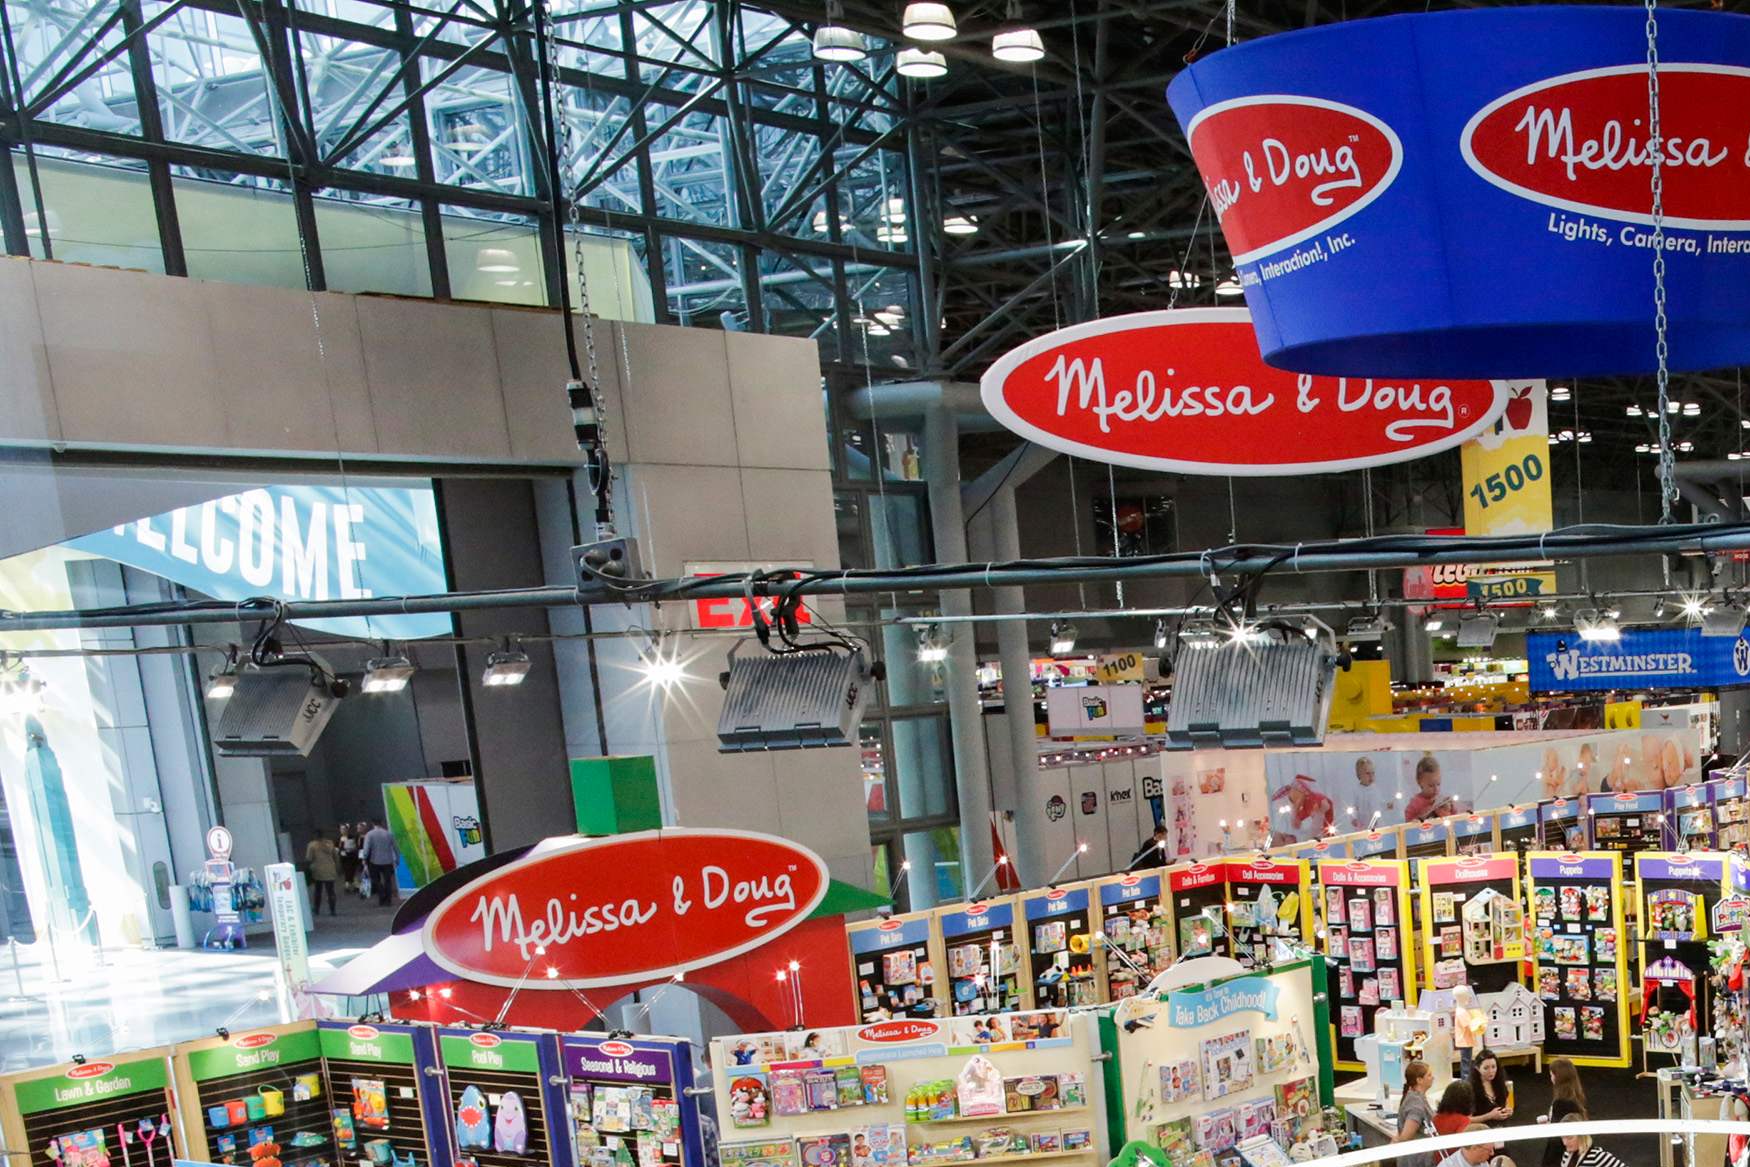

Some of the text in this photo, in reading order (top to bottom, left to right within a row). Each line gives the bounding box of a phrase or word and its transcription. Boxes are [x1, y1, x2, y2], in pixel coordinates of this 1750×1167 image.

[1515, 105, 1728, 181] Melissa
[1243, 138, 1362, 206] & Doug
[1547, 212, 1613, 247] Lights,
[1620, 226, 1701, 256] Camera,
[1260, 232, 1356, 281] Interaction!, Inc.
[1044, 354, 1275, 433] Melissa
[1337, 377, 1455, 442] Doug
[1469, 453, 1544, 510] 1500
[1103, 654, 1136, 677] 1100
[1546, 648, 1698, 681] WESTMINSTER
[1559, 865, 1584, 876] Puppets
[470, 865, 796, 960] Melissa & Doug
[1175, 1003, 1195, 1024] Take
[1197, 1001, 1218, 1022] Back
[1220, 989, 1266, 1013] Childhood!
[865, 1026, 902, 1039] Melissa
[911, 1024, 936, 1038] Doug
[236, 1050, 280, 1068] Sand Play
[350, 1041, 382, 1058] Sand Play
[487, 1051, 503, 1067] Play
[581, 1056, 656, 1078] Seasonal & Religious
[55, 1077, 131, 1102] Lawn & Garden
